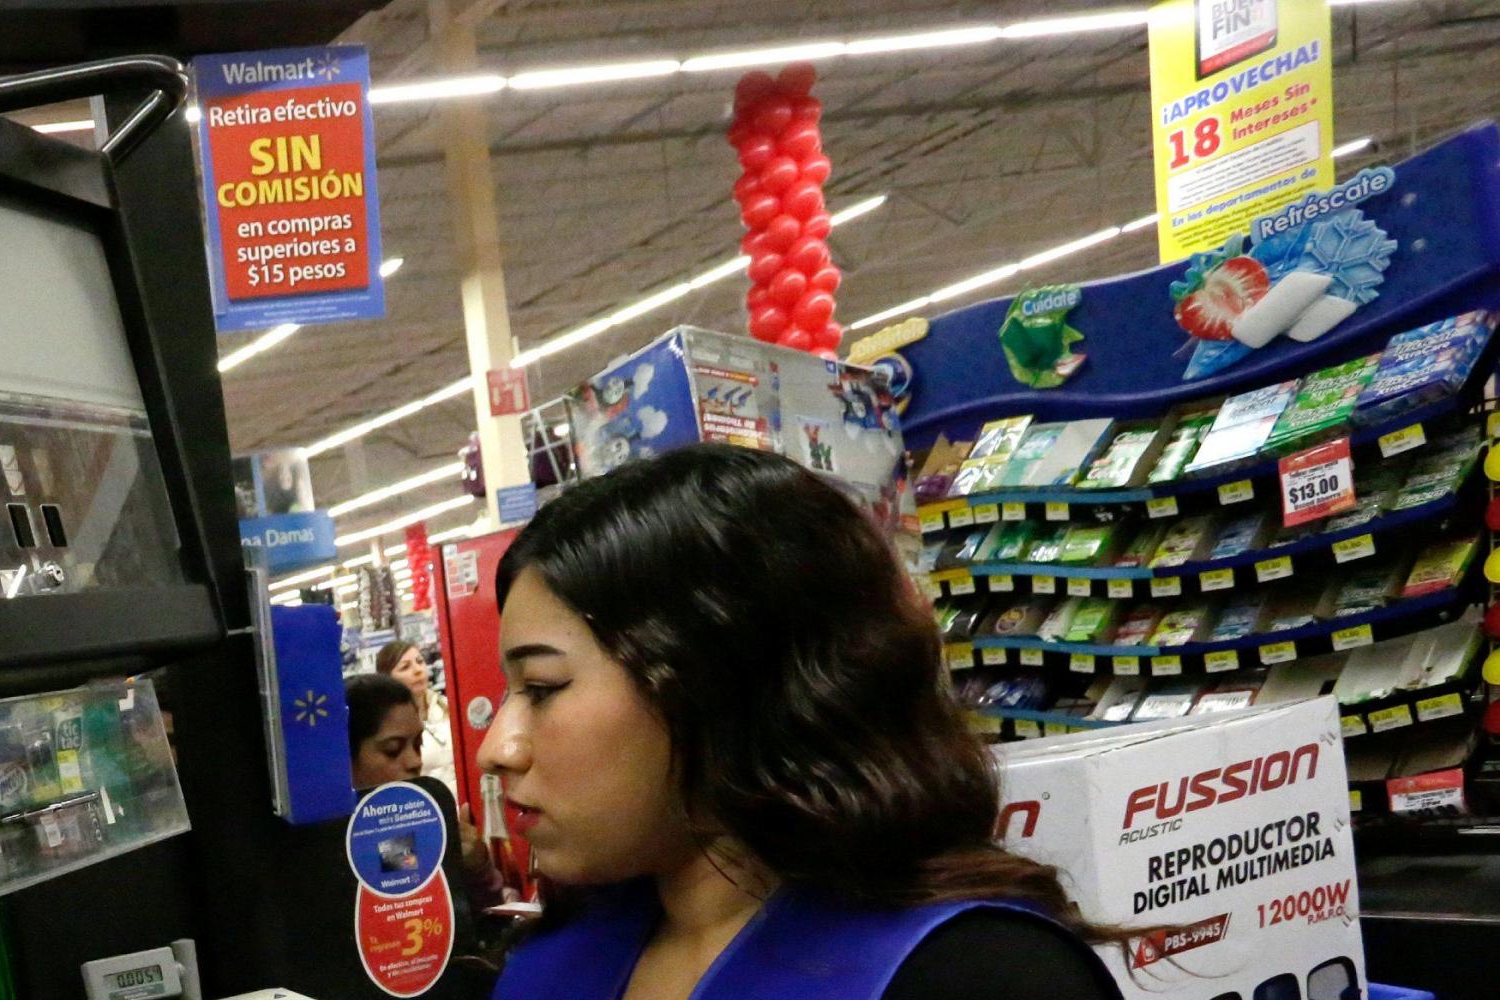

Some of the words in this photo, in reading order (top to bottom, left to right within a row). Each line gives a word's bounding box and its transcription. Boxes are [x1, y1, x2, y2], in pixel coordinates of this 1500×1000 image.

[1212, 8, 1250, 40] FIN
[222, 58, 315, 85] Walmart
[1163, 40, 1319, 125] ¡APROVECHA!
[209, 106, 272, 127] Retira
[274, 97, 357, 122] efectivo
[1230, 95, 1279, 124] Meses
[1284, 82, 1310, 101] Sin
[250, 134, 322, 176] SIN
[1170, 117, 1221, 170] 18
[217, 168, 363, 207] COMISIÓN
[1259, 173, 1387, 239] Refréscate
[237, 220, 263, 239] en
[268, 213, 353, 236] compras
[237, 237, 340, 265] superiores
[344, 237, 356, 253] a
[248, 264, 284, 287] $15
[289, 261, 346, 286] pesos
[1289, 475, 1339, 504] $13.00
[266, 526, 314, 549] Damas
[1123, 743, 1319, 829] FUSSION
[362, 803, 397, 818] Ahorra
[1118, 818, 1183, 846] ACUSTIC
[1148, 811, 1321, 884] REPRODUCTOR
[1134, 875, 1210, 915] DIGITAL
[1216, 837, 1335, 891] MULTIMEDIA
[1257, 879, 1351, 929] 12000W
